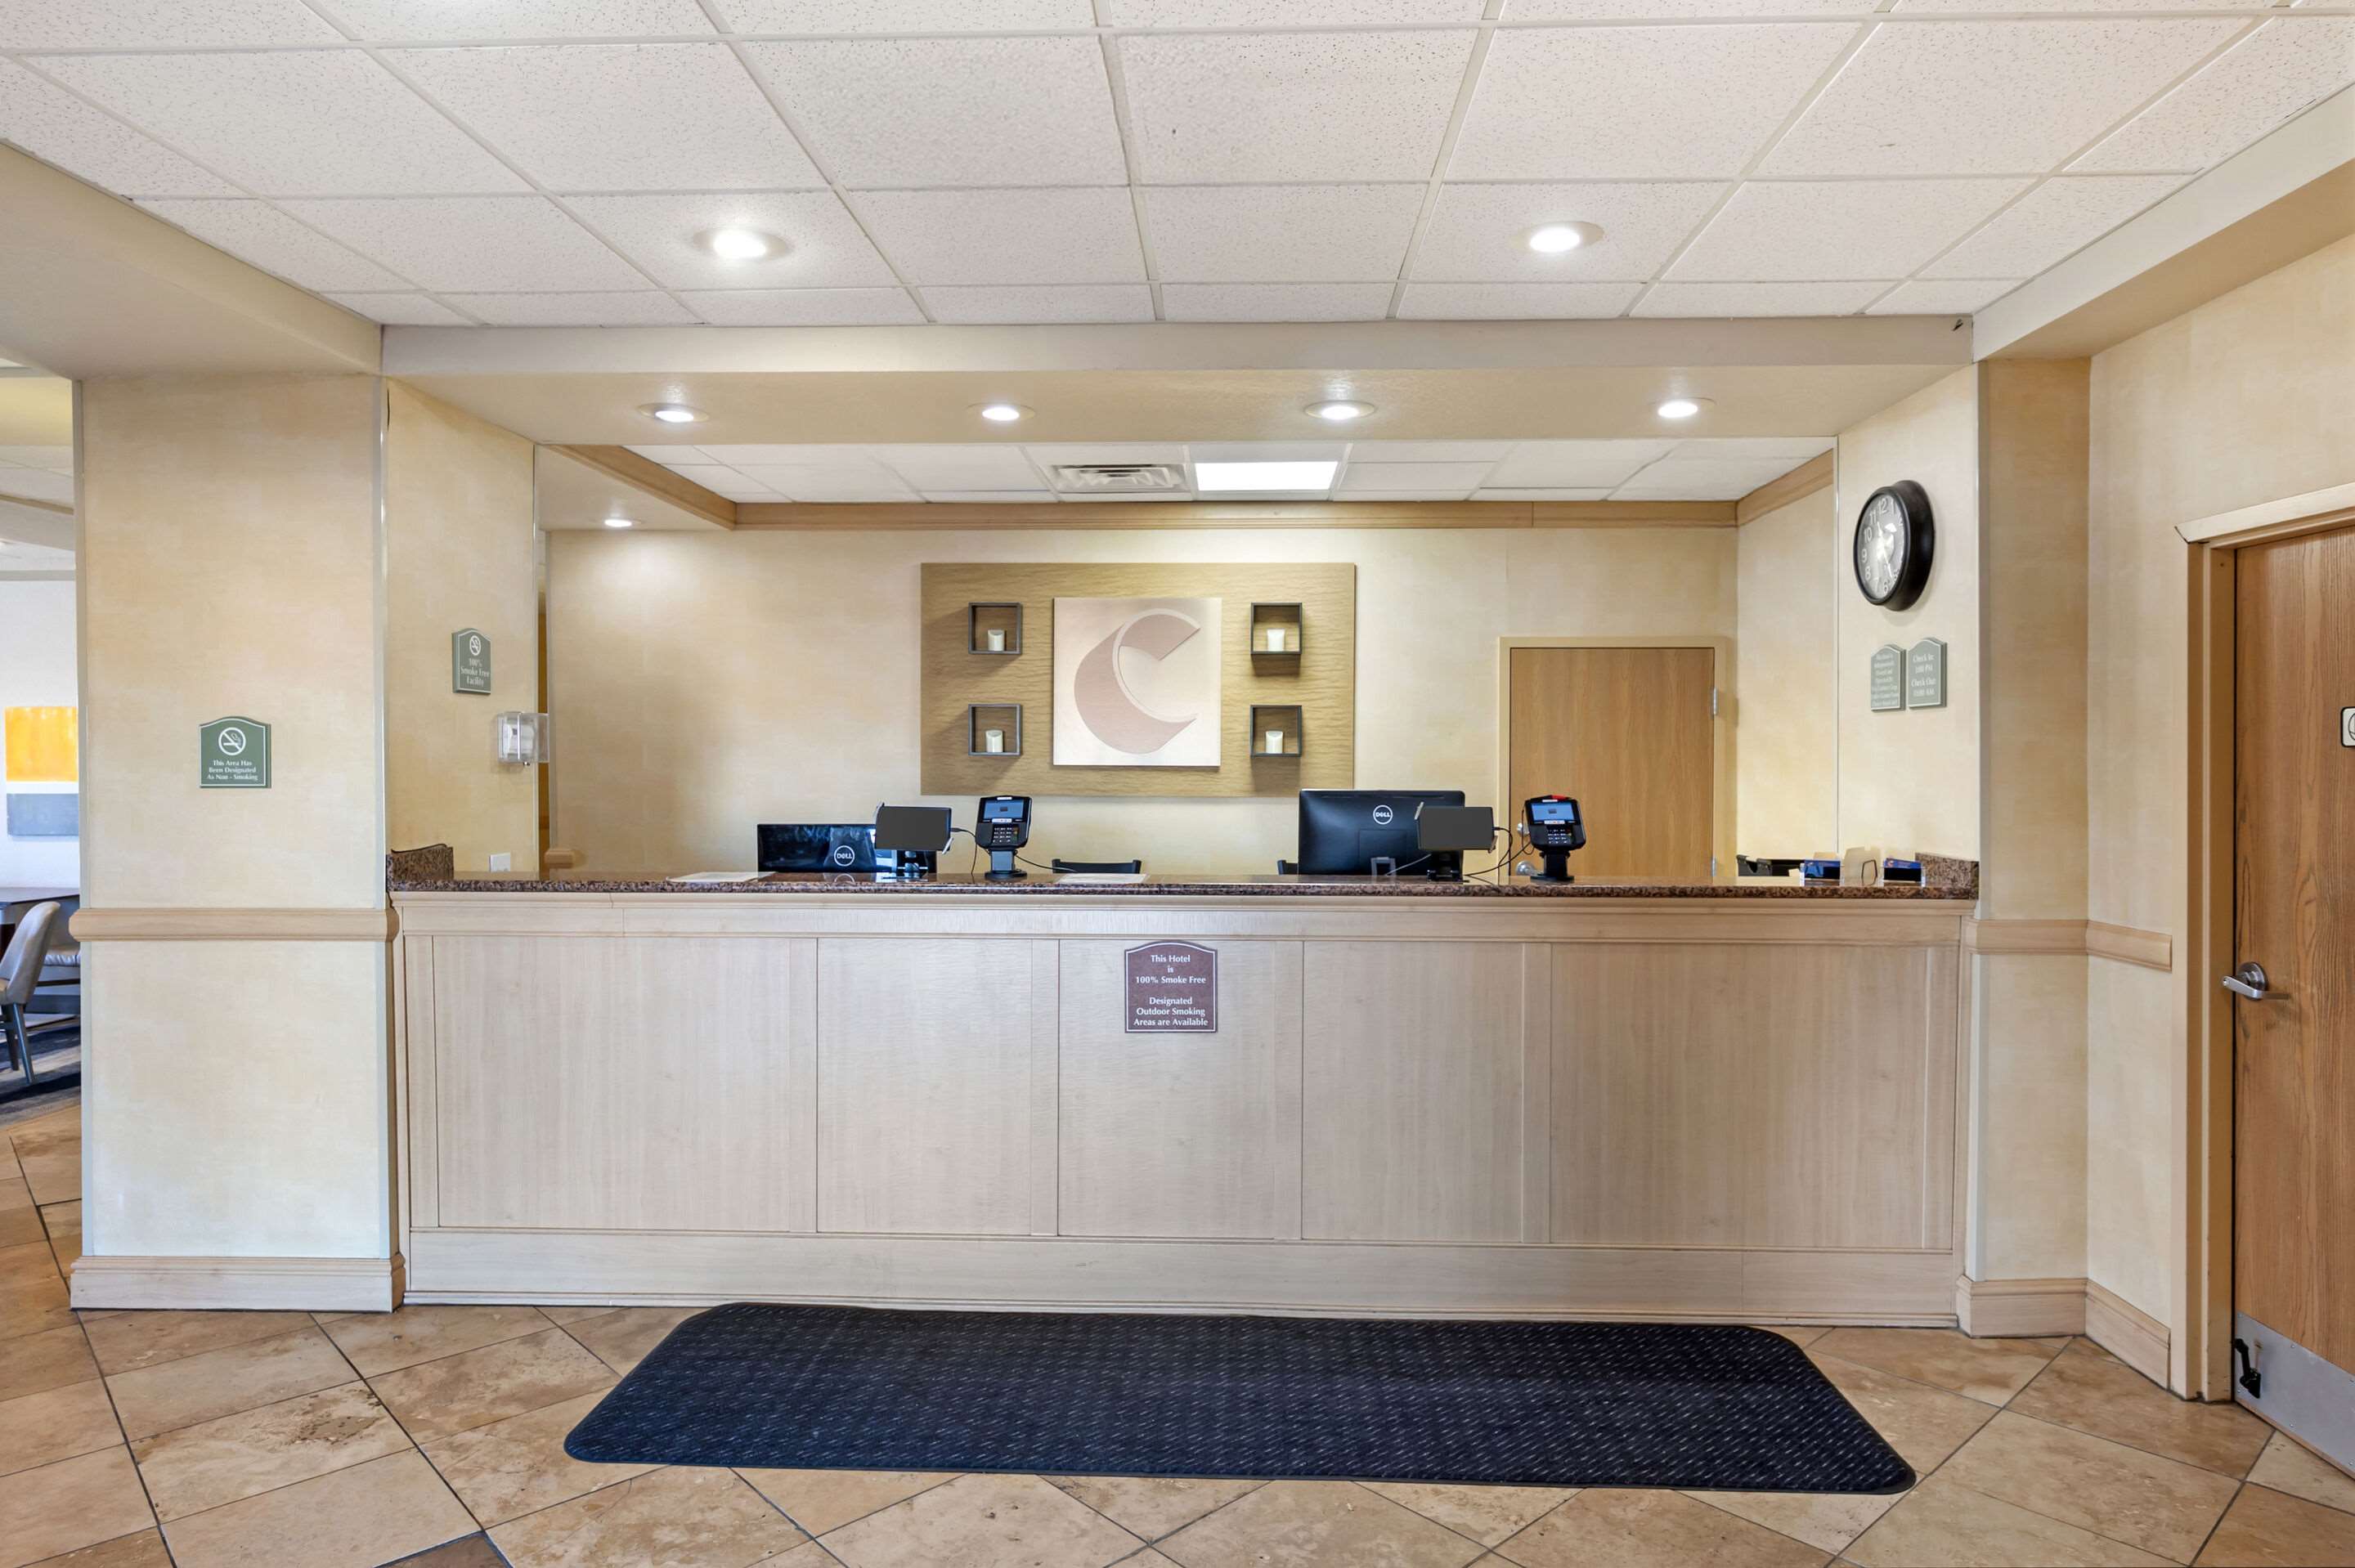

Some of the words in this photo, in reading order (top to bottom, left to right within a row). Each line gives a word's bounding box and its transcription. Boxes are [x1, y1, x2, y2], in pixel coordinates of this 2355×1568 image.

[1878, 497, 1888, 515] 12
[1890, 497, 1896, 515] 1
[1869, 509, 1877, 525] 11
[1864, 526, 1873, 544] 10
[1861, 549, 1868, 562] 9
[1865, 566, 1872, 580] 8
[469, 657, 482, 667] 100%
[460, 665, 478, 676] Smoke
[479, 668, 490, 678] Free
[467, 675, 484, 687] Facility
[233, 773, 258, 782] Smoking
[1151, 955, 1167, 963] This
[1169, 955, 1191, 963] Hotel
[1167, 965, 1174, 973] is
[1136, 976, 1159, 984] 100%
[1161, 975, 1187, 984] Smoke
[1189, 975, 1206, 984] Free
[1149, 997, 1192, 1006] Designated
[1136, 1007, 1170, 1015] Outdoor
[1172, 1007, 1205, 1017] Smoking
[1133, 1018, 1156, 1026] Areas
[1172, 1018, 1209, 1026] Available
